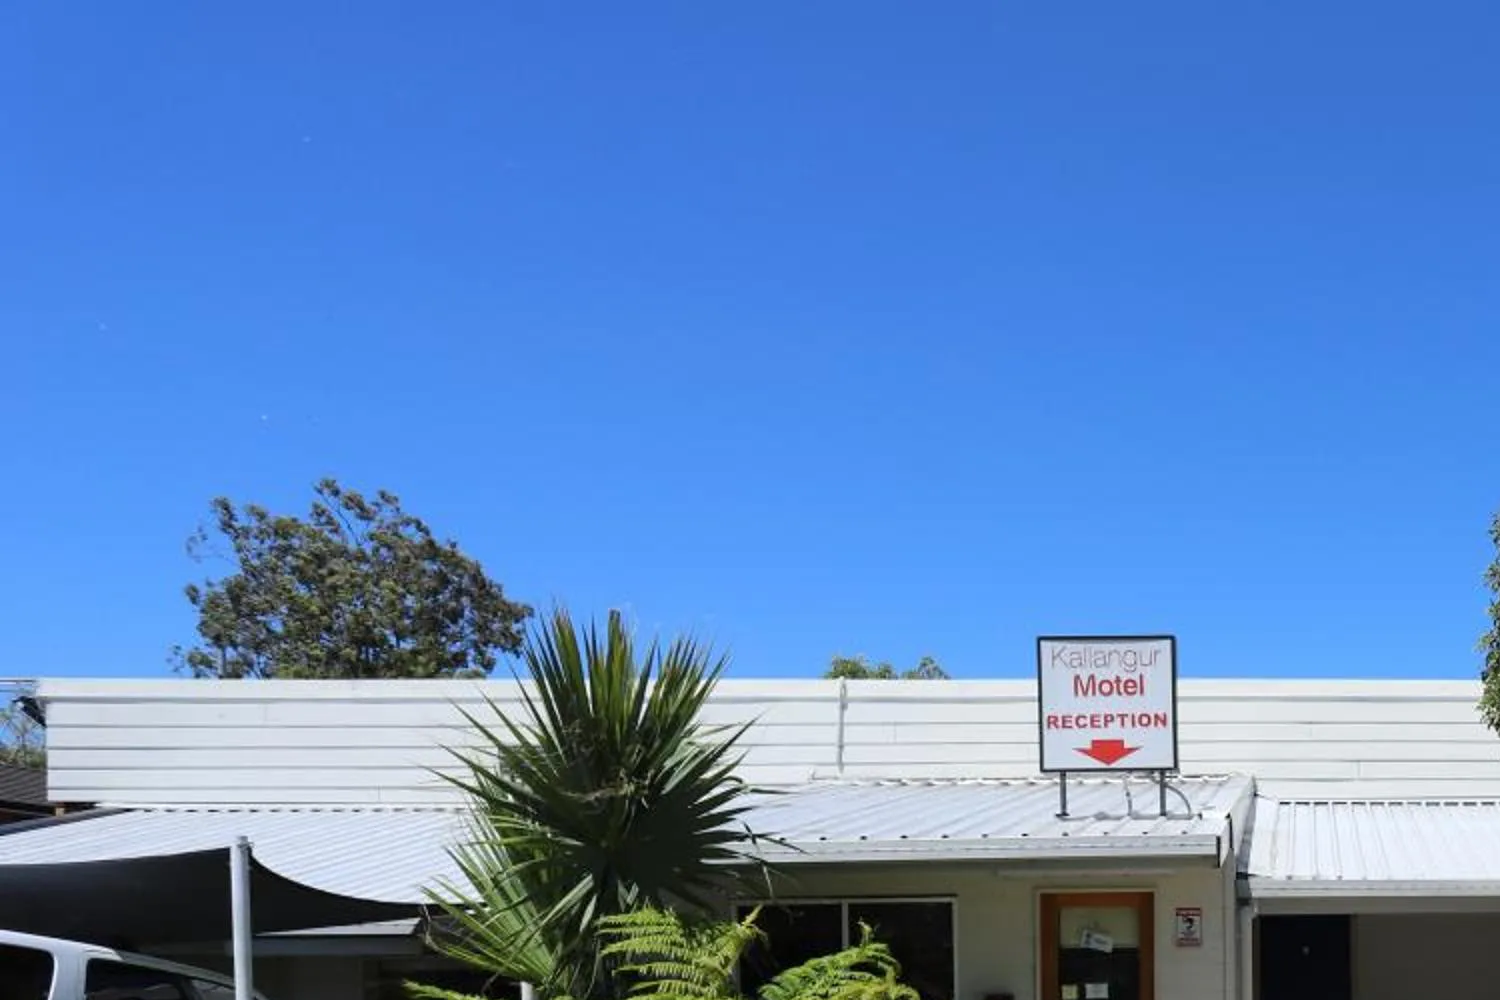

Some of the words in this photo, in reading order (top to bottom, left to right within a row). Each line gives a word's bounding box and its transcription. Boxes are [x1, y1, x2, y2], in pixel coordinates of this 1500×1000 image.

[1052, 646, 1161, 672] Kallangur
[1074, 674, 1145, 697] Motel
[1047, 713, 1167, 729] RECEPTION
